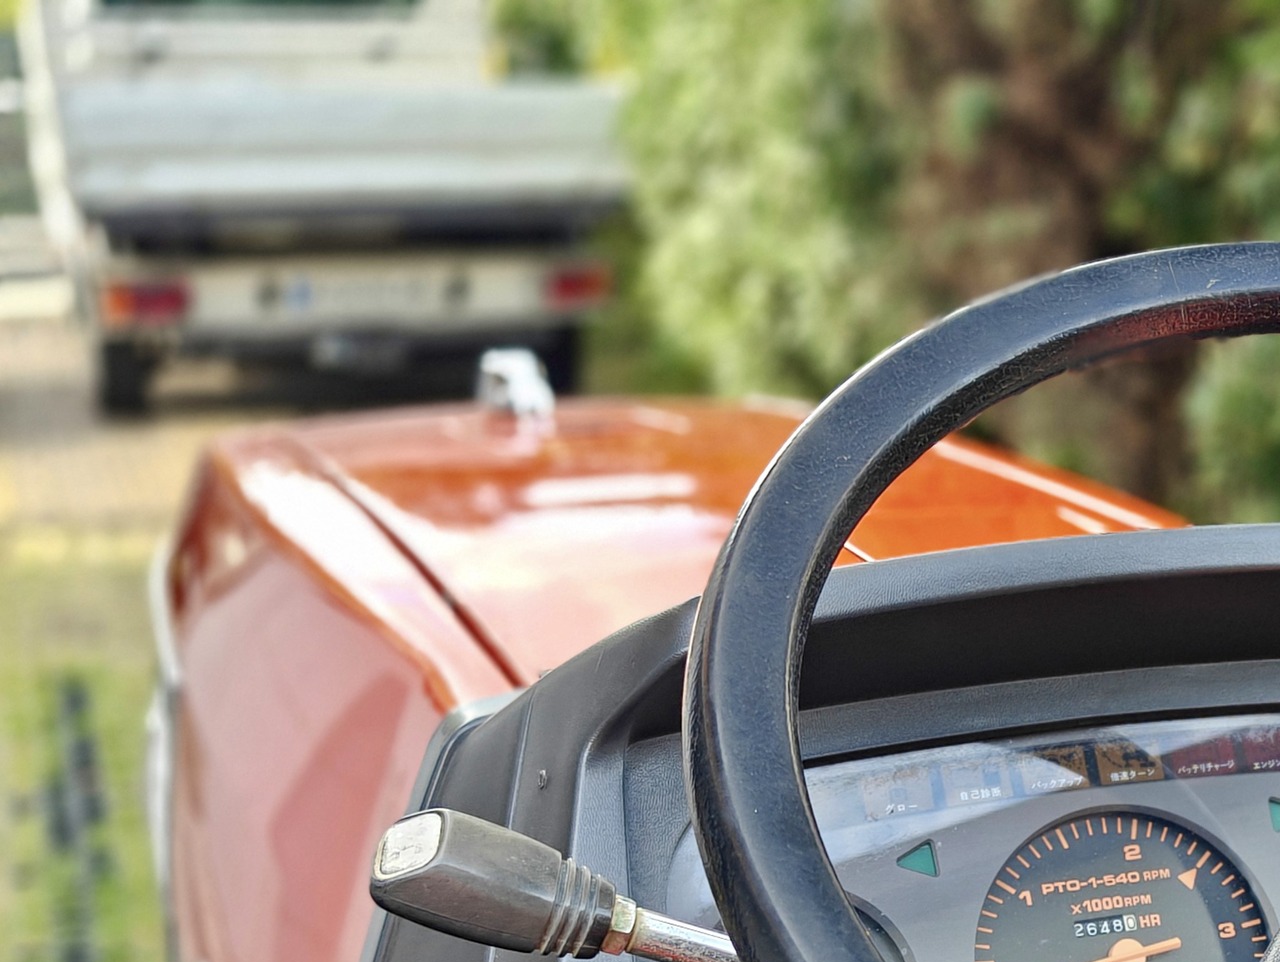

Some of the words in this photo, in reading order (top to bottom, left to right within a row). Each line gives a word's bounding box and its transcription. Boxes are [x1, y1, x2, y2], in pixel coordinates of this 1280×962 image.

[1177, 759, 1236, 775] バッテリチャージ
[1110, 768, 1156, 782] 倍速ターン
[1031, 776, 1084, 790] バックアップ
[960, 787, 1002, 801] 自己診断
[885, 802, 919, 815] グロー
[1123, 844, 1142, 861] 2
[1041, 870, 1140, 895] PTO-1-540
[1142, 868, 1171, 882] RPM
[1018, 890, 1033, 907] 1
[1139, 914, 1161, 929] HR
[1218, 922, 1237, 940] 3
